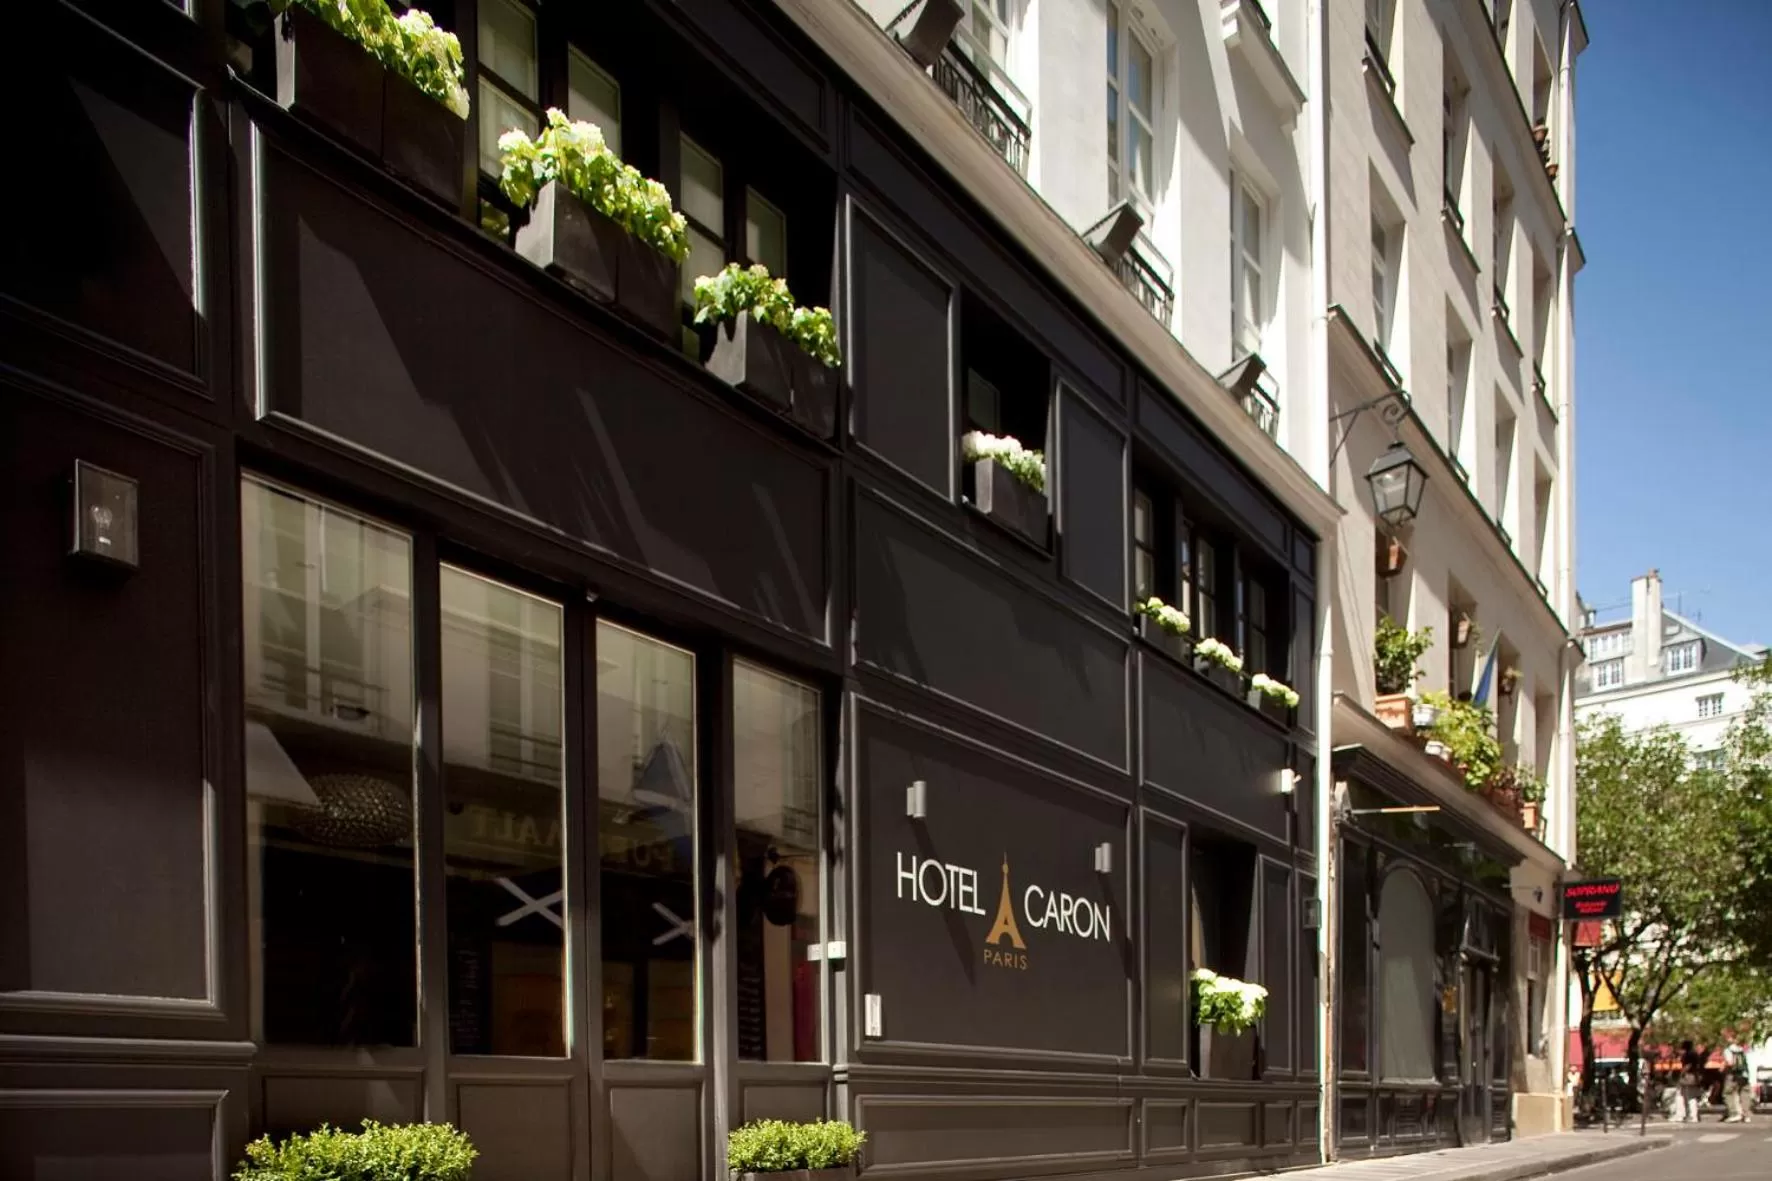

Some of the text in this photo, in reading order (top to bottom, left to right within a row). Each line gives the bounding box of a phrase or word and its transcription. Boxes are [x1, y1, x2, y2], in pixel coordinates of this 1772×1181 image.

[896, 851, 1111, 943] HOTEL CARON
[983, 949, 1028, 970] PARIS
